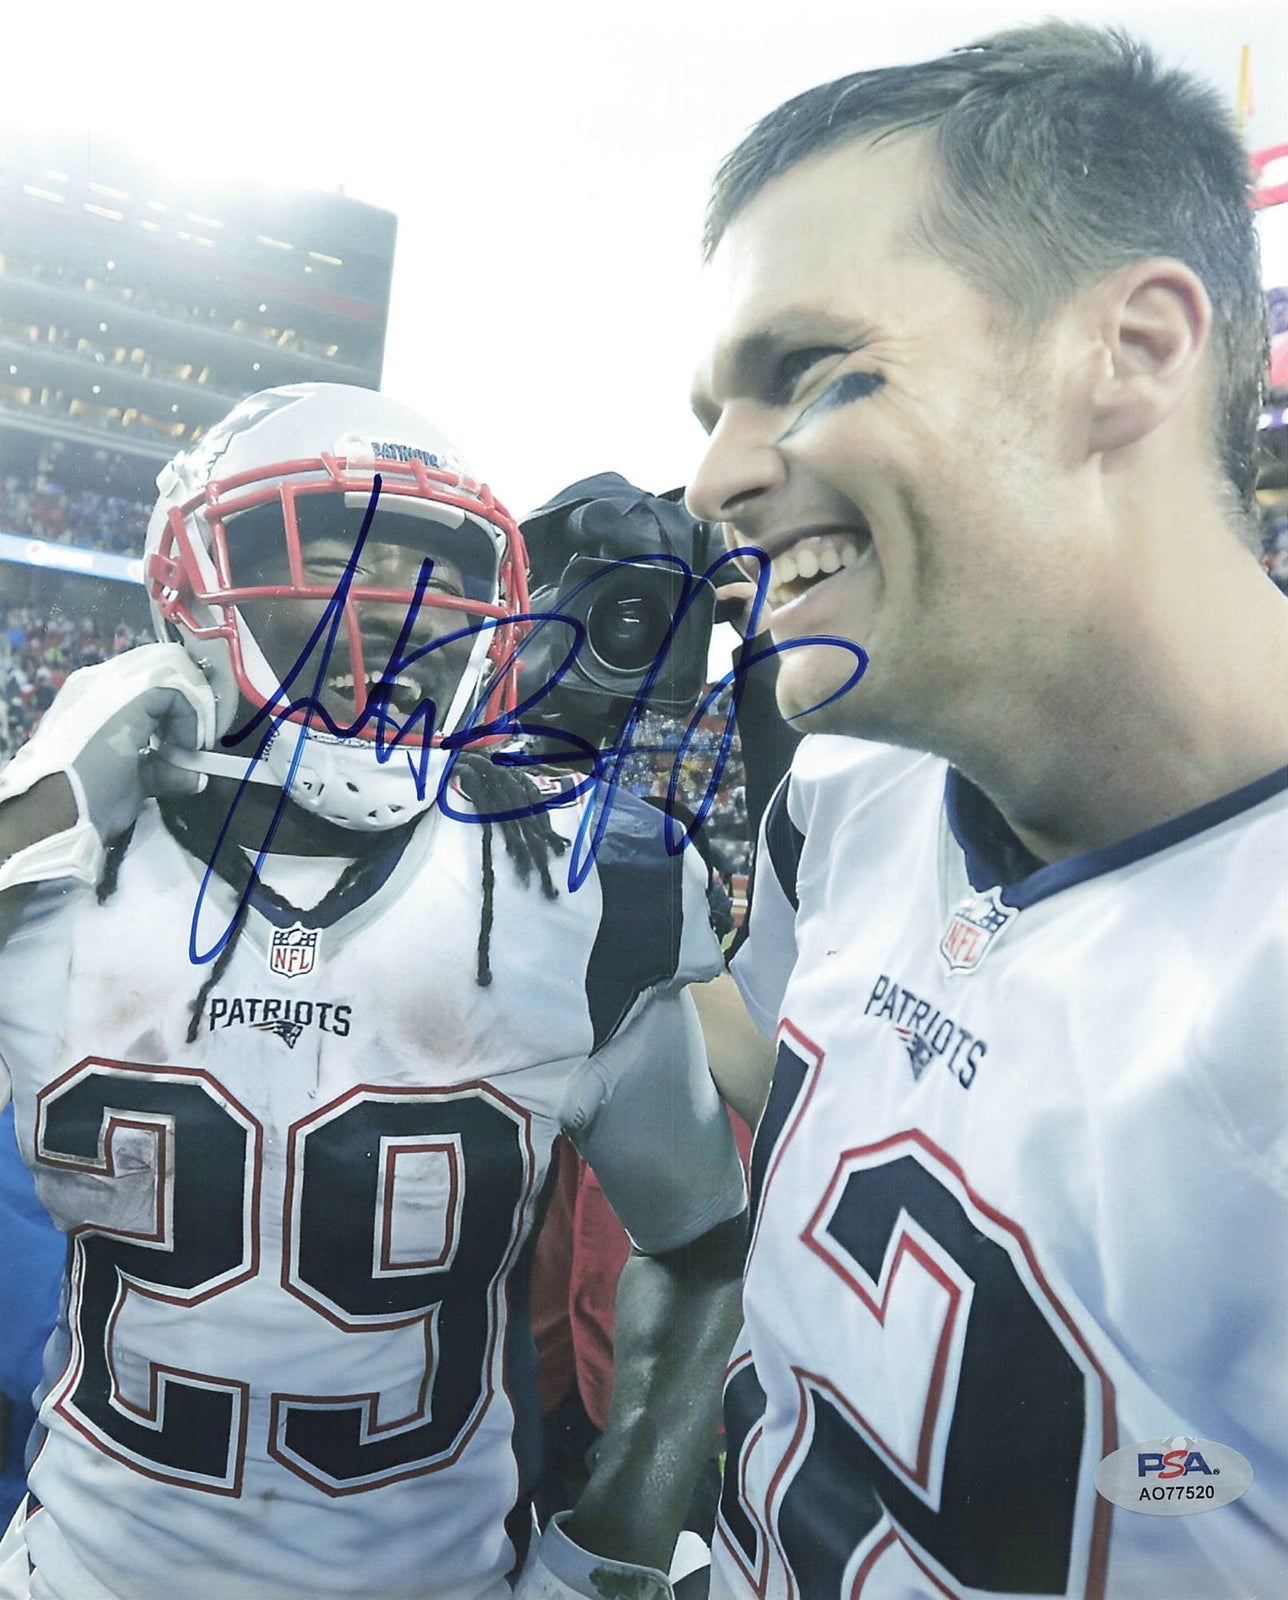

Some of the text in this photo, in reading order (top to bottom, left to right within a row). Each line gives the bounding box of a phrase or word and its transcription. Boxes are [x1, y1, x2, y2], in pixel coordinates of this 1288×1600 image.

[274, 948, 310, 973] NFL
[944, 919, 981, 963] NFL
[209, 998, 352, 1037] PATRIOTS
[864, 974, 988, 1090] PATRIOTS
[35, 1056, 534, 1497] 29
